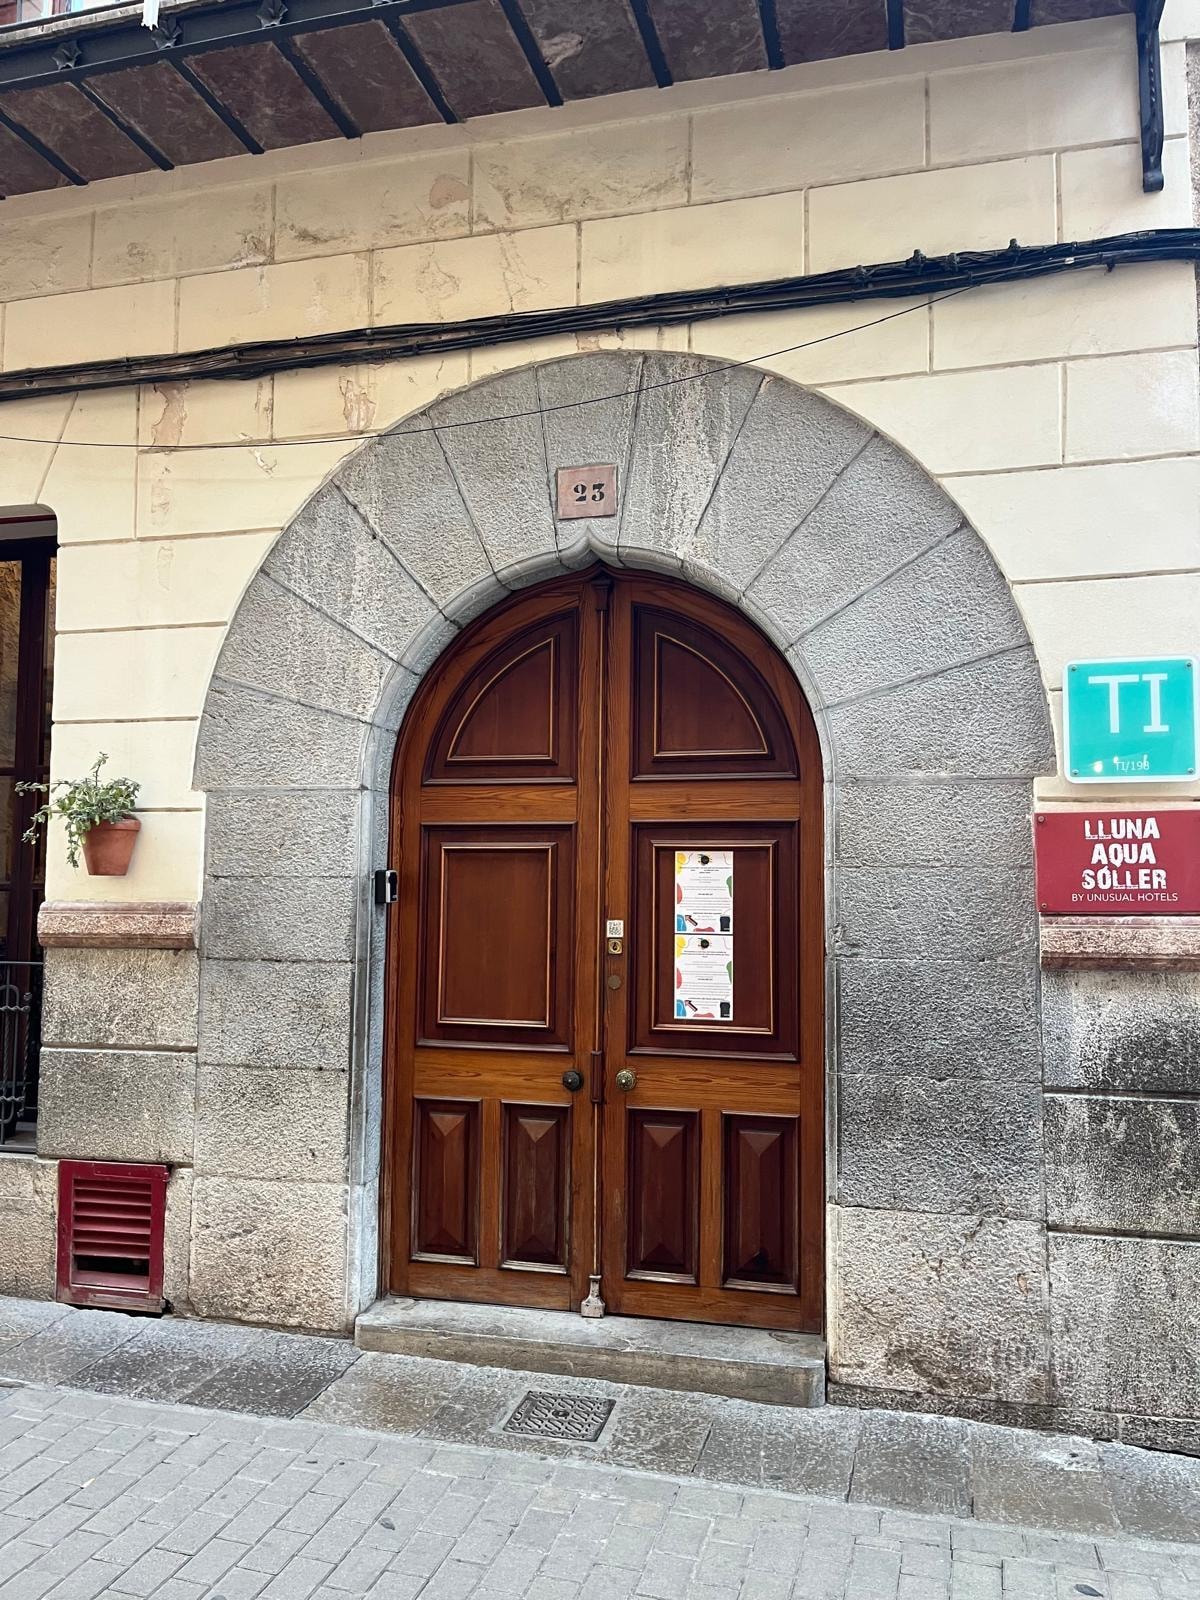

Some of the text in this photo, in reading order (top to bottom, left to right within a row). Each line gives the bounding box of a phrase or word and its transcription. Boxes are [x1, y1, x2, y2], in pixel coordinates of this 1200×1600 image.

[573, 483, 605, 502] 23
[1088, 673, 1169, 733] TI
[1084, 817, 1160, 839] LLUNA
[1091, 842, 1156, 867] AQUA
[1081, 866, 1167, 889] SÓLLER
[1071, 892, 1178, 901] BY UNUSUAL HOTELS
